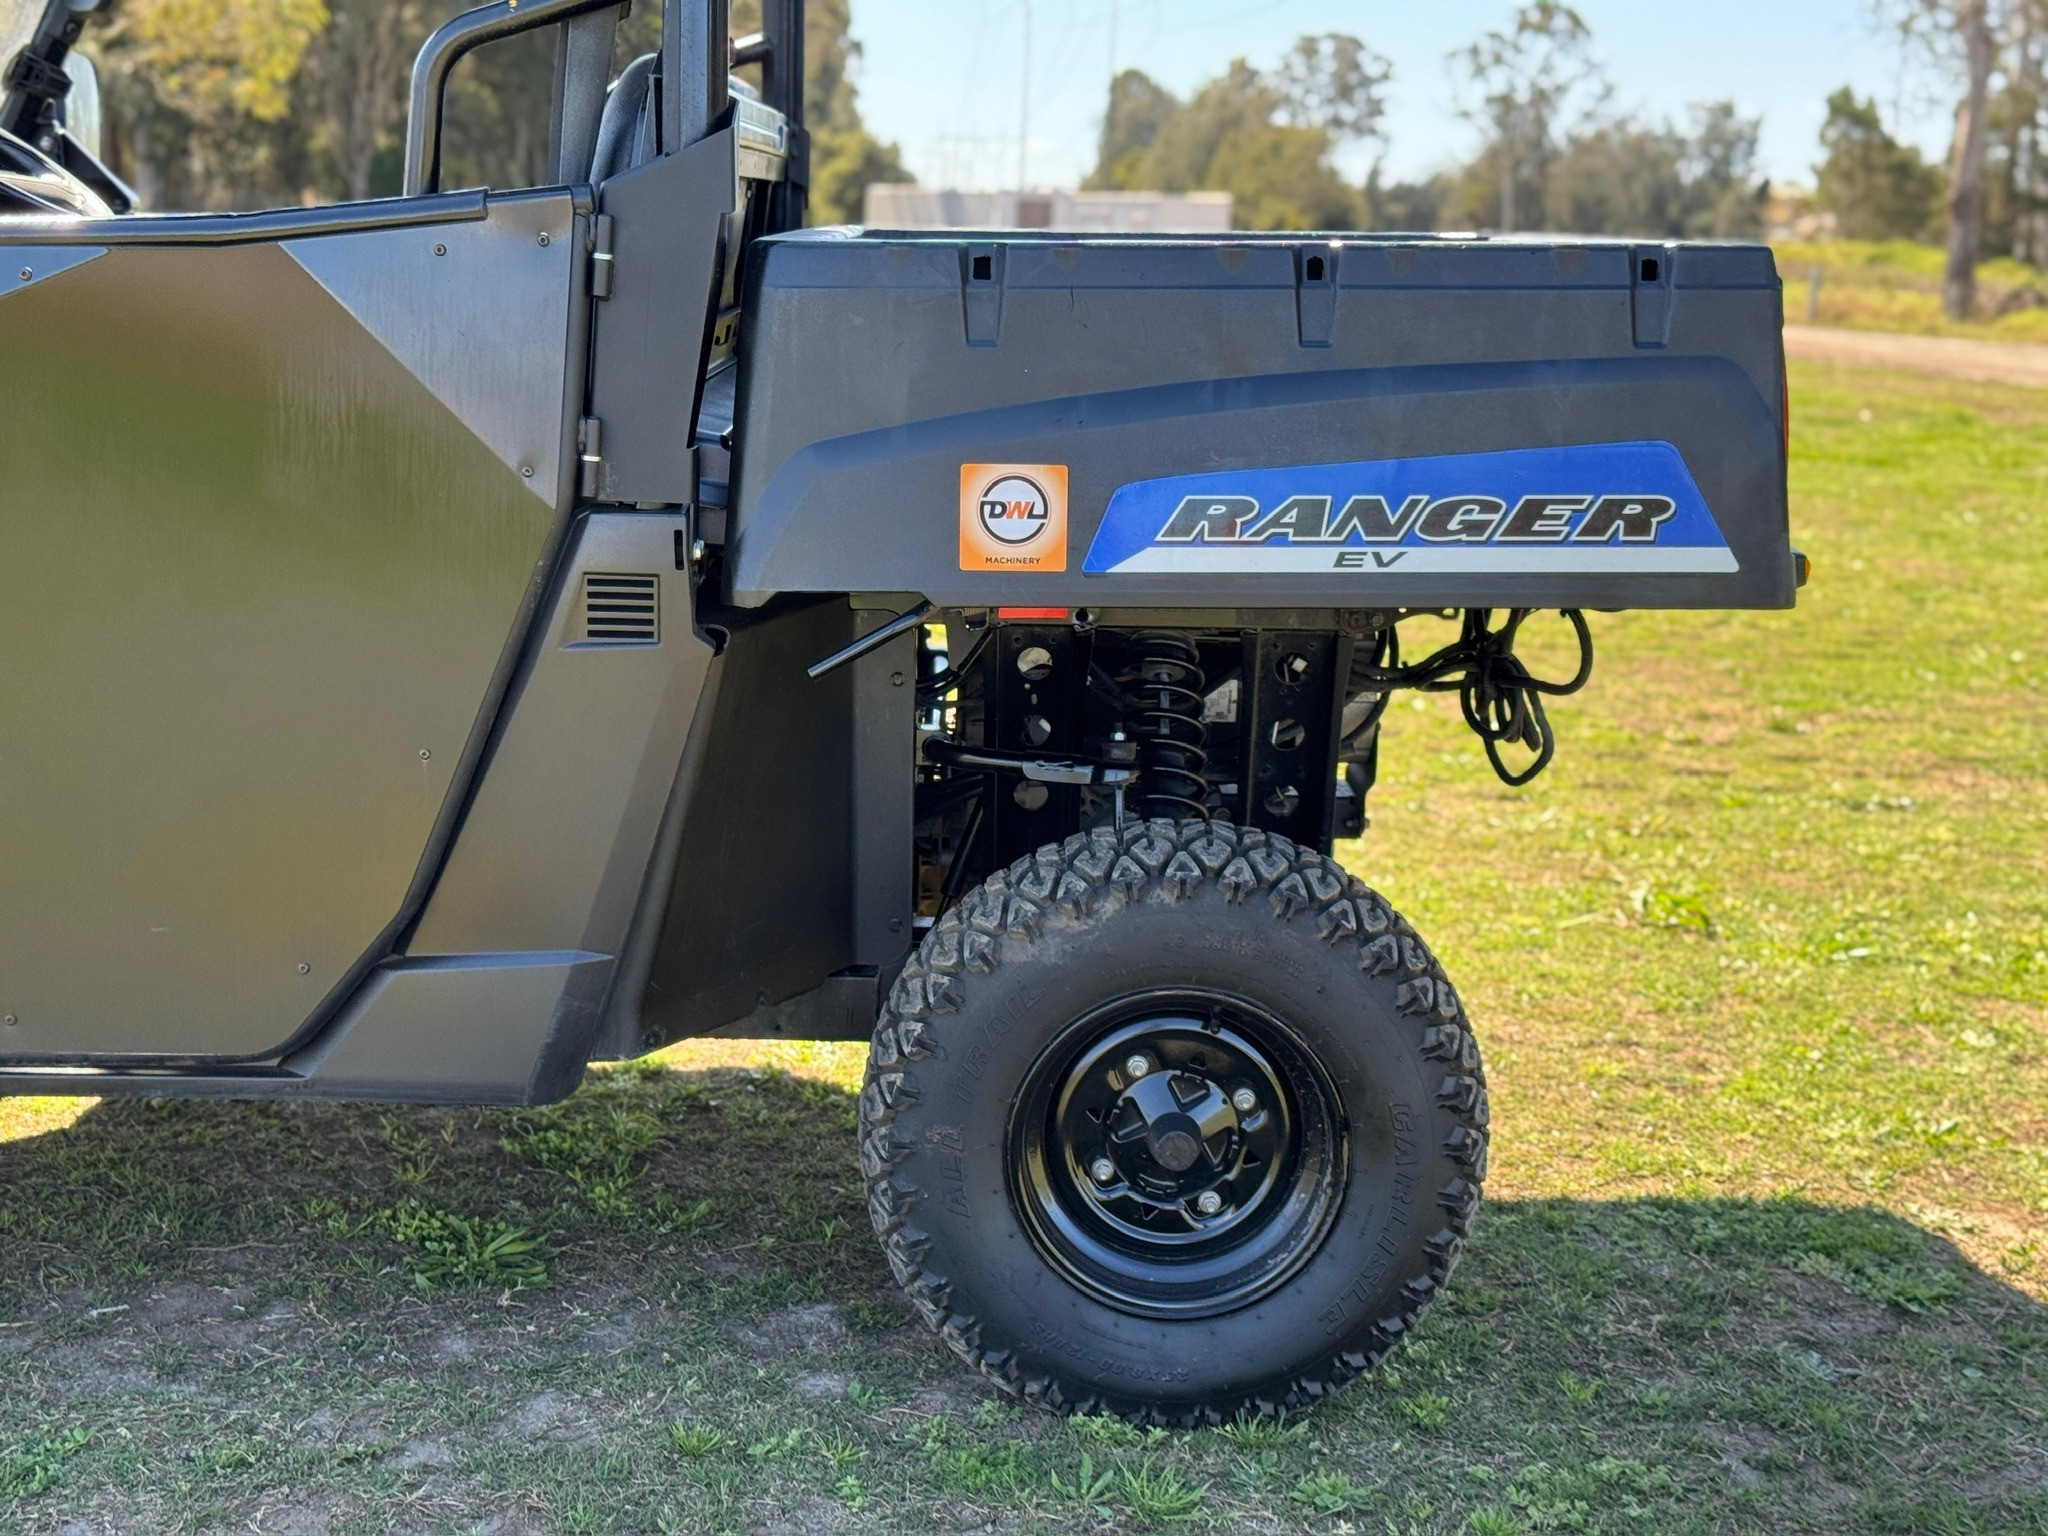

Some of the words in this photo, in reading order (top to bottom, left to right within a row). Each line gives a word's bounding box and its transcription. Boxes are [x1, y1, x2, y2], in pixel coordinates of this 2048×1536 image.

[980, 500, 1048, 520] DWL
[1155, 494, 1677, 543] RANGER
[985, 557, 1041, 565] MACHINERY
[1333, 551, 1408, 569] EV
[952, 986, 1047, 1104] TRAIL
[1316, 1101, 1418, 1336] CARLISLE
